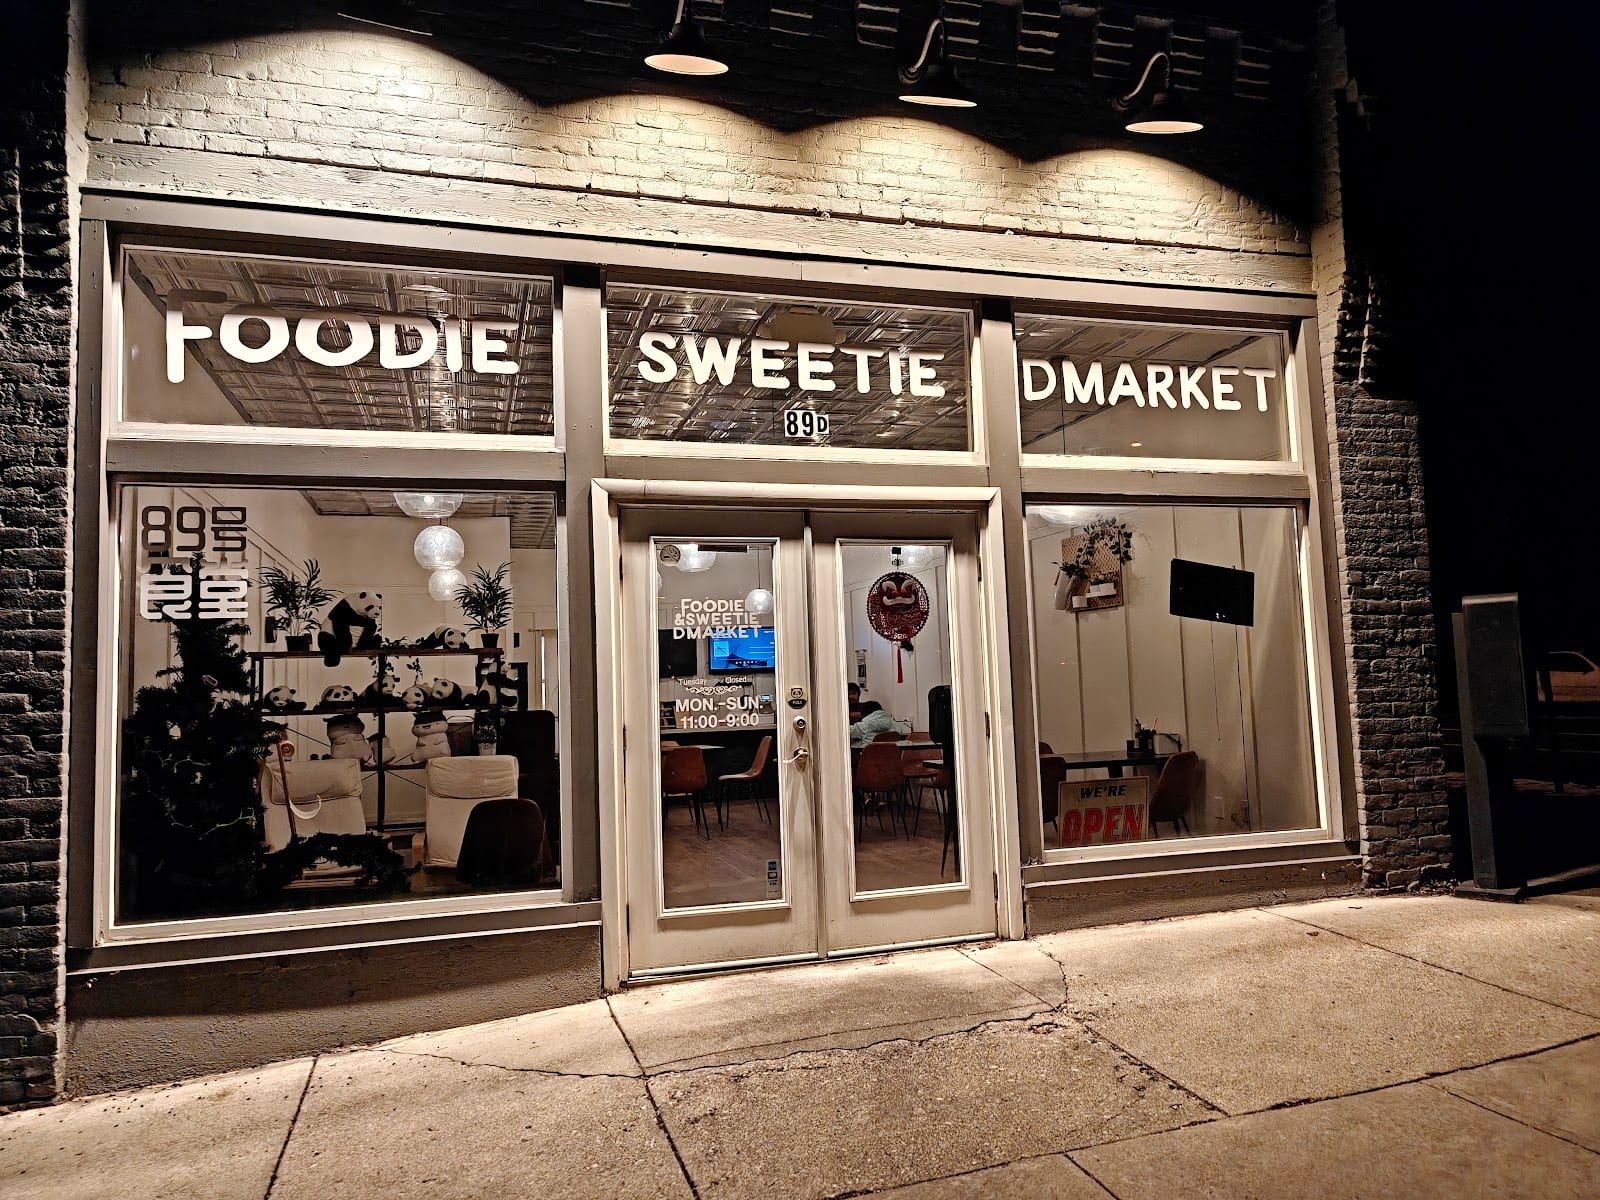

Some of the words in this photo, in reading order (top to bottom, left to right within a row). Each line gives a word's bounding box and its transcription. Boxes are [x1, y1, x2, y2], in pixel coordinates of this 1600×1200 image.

[166, 288, 521, 384] FOODIE
[637, 331, 946, 398] SWEETIE
[1022, 358, 1277, 412] DMARKET
[786, 411, 828, 436] 89D
[681, 598, 745, 617] FOODIE
[674, 612, 760, 626] &SWEETIE
[673, 625, 762, 639] DMARKET
[679, 678, 707, 687] Tuesday
[725, 675, 747, 684] Closed
[1080, 785, 1127, 798] WE'RE
[1062, 803, 1144, 847] OPEN
